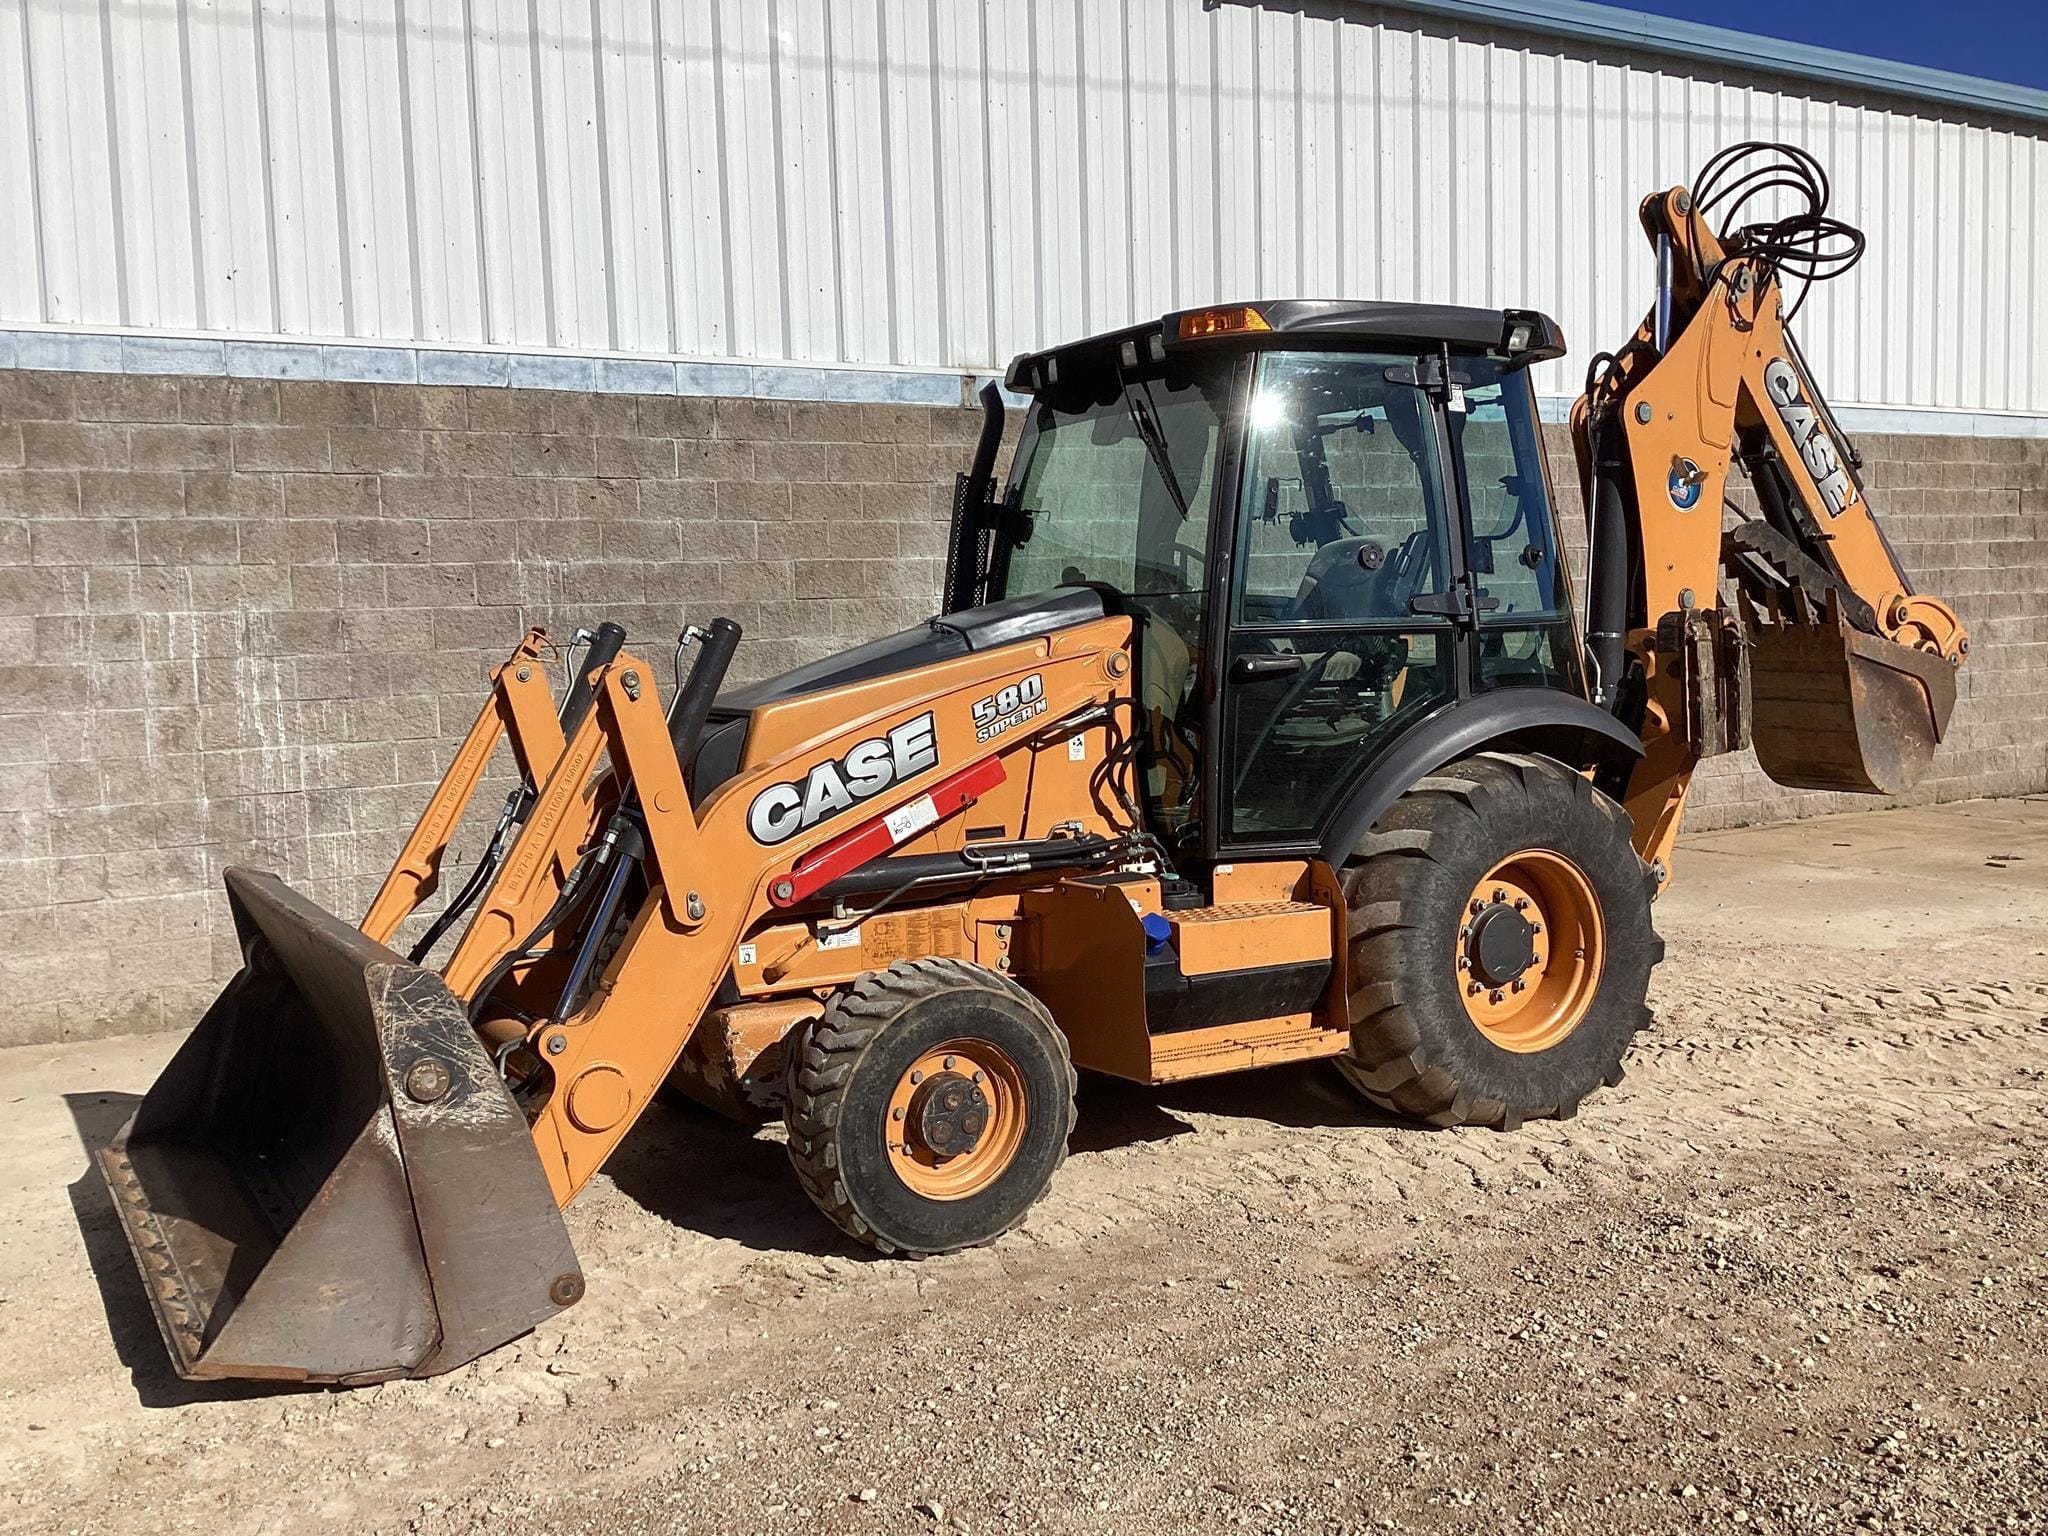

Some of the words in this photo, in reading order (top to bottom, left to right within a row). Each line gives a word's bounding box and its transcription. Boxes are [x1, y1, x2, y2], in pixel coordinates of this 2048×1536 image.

[1765, 359, 1853, 518] CASE
[971, 673, 1043, 729] 580
[976, 706, 1033, 743] SUPER
[1034, 697, 1048, 715] N
[748, 711, 939, 845] CASE
